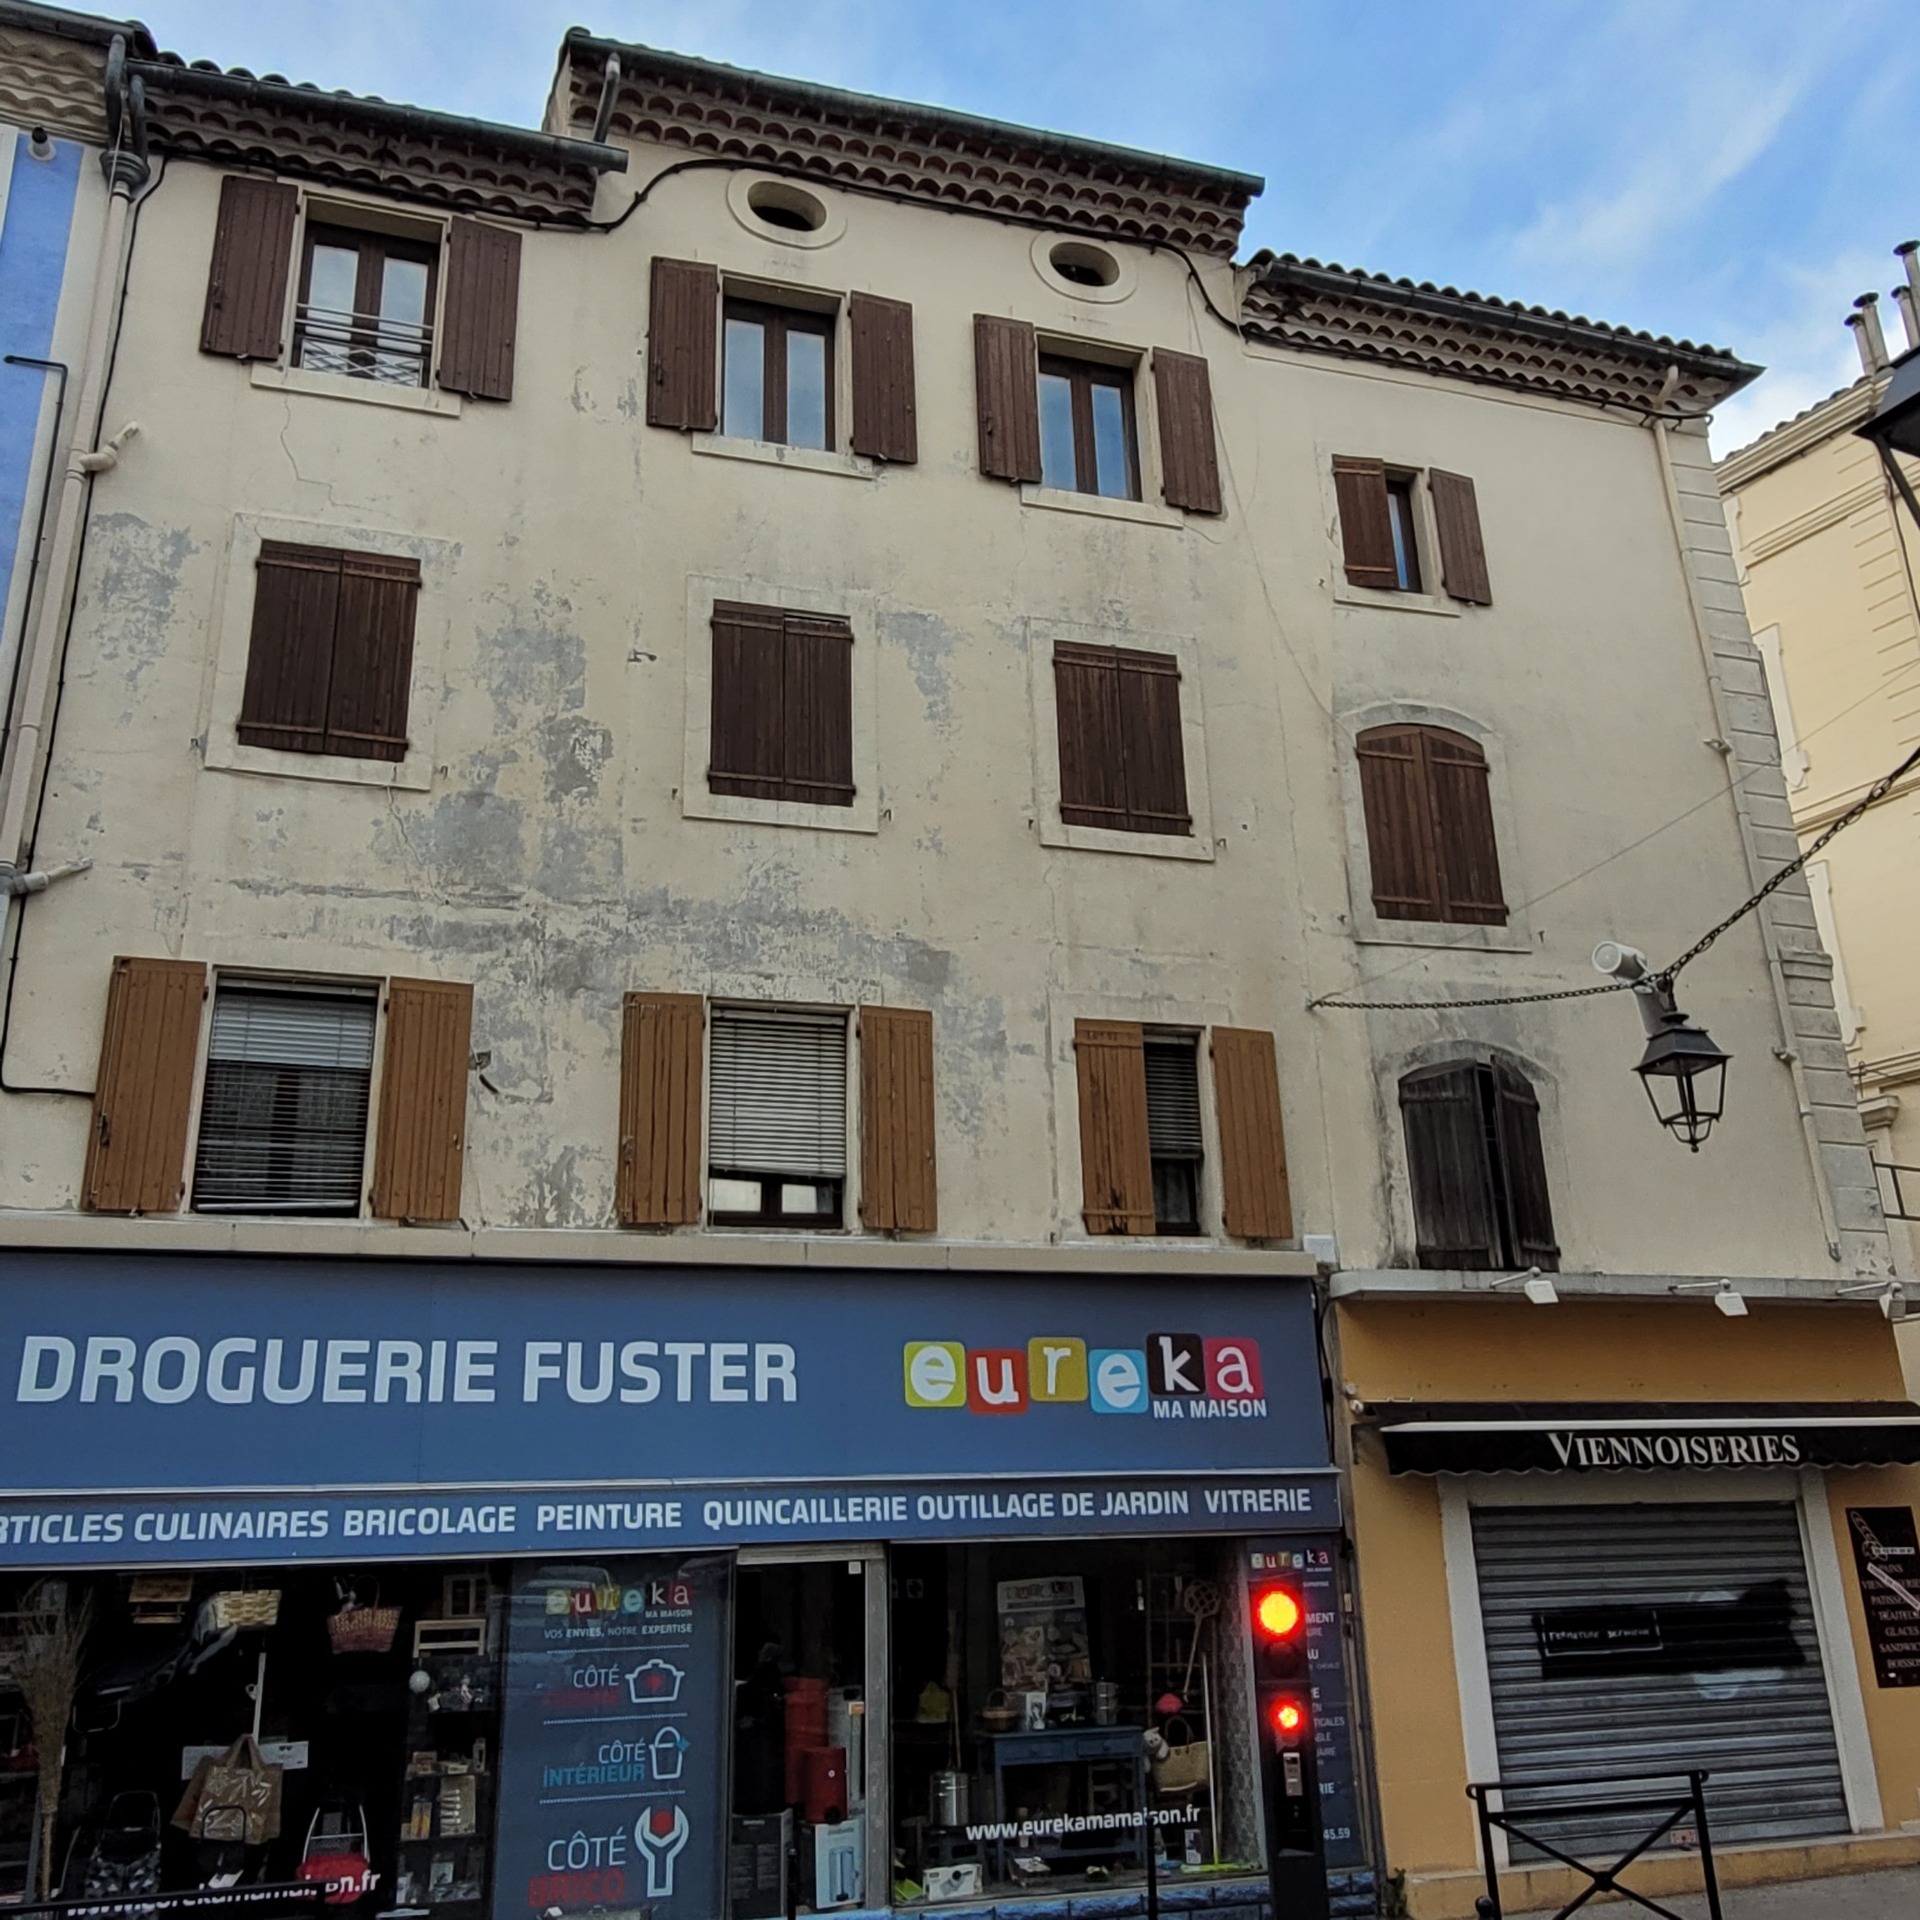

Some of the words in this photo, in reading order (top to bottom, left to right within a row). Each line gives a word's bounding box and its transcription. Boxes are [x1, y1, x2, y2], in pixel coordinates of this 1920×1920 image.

[17, 1335, 498, 1404] DROGUERIE
[523, 1340, 797, 1404] FUSTER
[905, 1334, 1258, 1411] eureka
[1153, 1400, 1185, 1419] MA
[1189, 1398, 1268, 1418] MAISON
[1547, 1431, 1800, 1467] VIENNOISERIES
[134, 1509, 329, 1542] CULINAIRES
[343, 1505, 517, 1537] BRICOLAGE
[537, 1502, 682, 1531] PEINTURE
[703, 1495, 909, 1531] QUINCAILLERIE
[917, 1492, 1055, 1521] OUTILLAGE
[1062, 1492, 1095, 1518] DE
[1100, 1489, 1190, 1517] JARDIN
[1203, 1488, 1312, 1515] VITRERIE
[1250, 1549, 1330, 1569] eureka
[546, 1580, 691, 1615] eureka
[645, 1609, 659, 1619] MA
[659, 1607, 693, 1619] MAISON
[543, 1629, 563, 1640] VOS
[641, 1622, 693, 1635] EXPERTISE
[573, 1664, 620, 1689] CÔTÉ
[598, 1737, 646, 1765] CÔTÉ
[542, 1760, 647, 1788] INTÉRIEUR
[547, 1826, 627, 1872] CÔTÉ
[527, 1865, 626, 1908] BRICO
